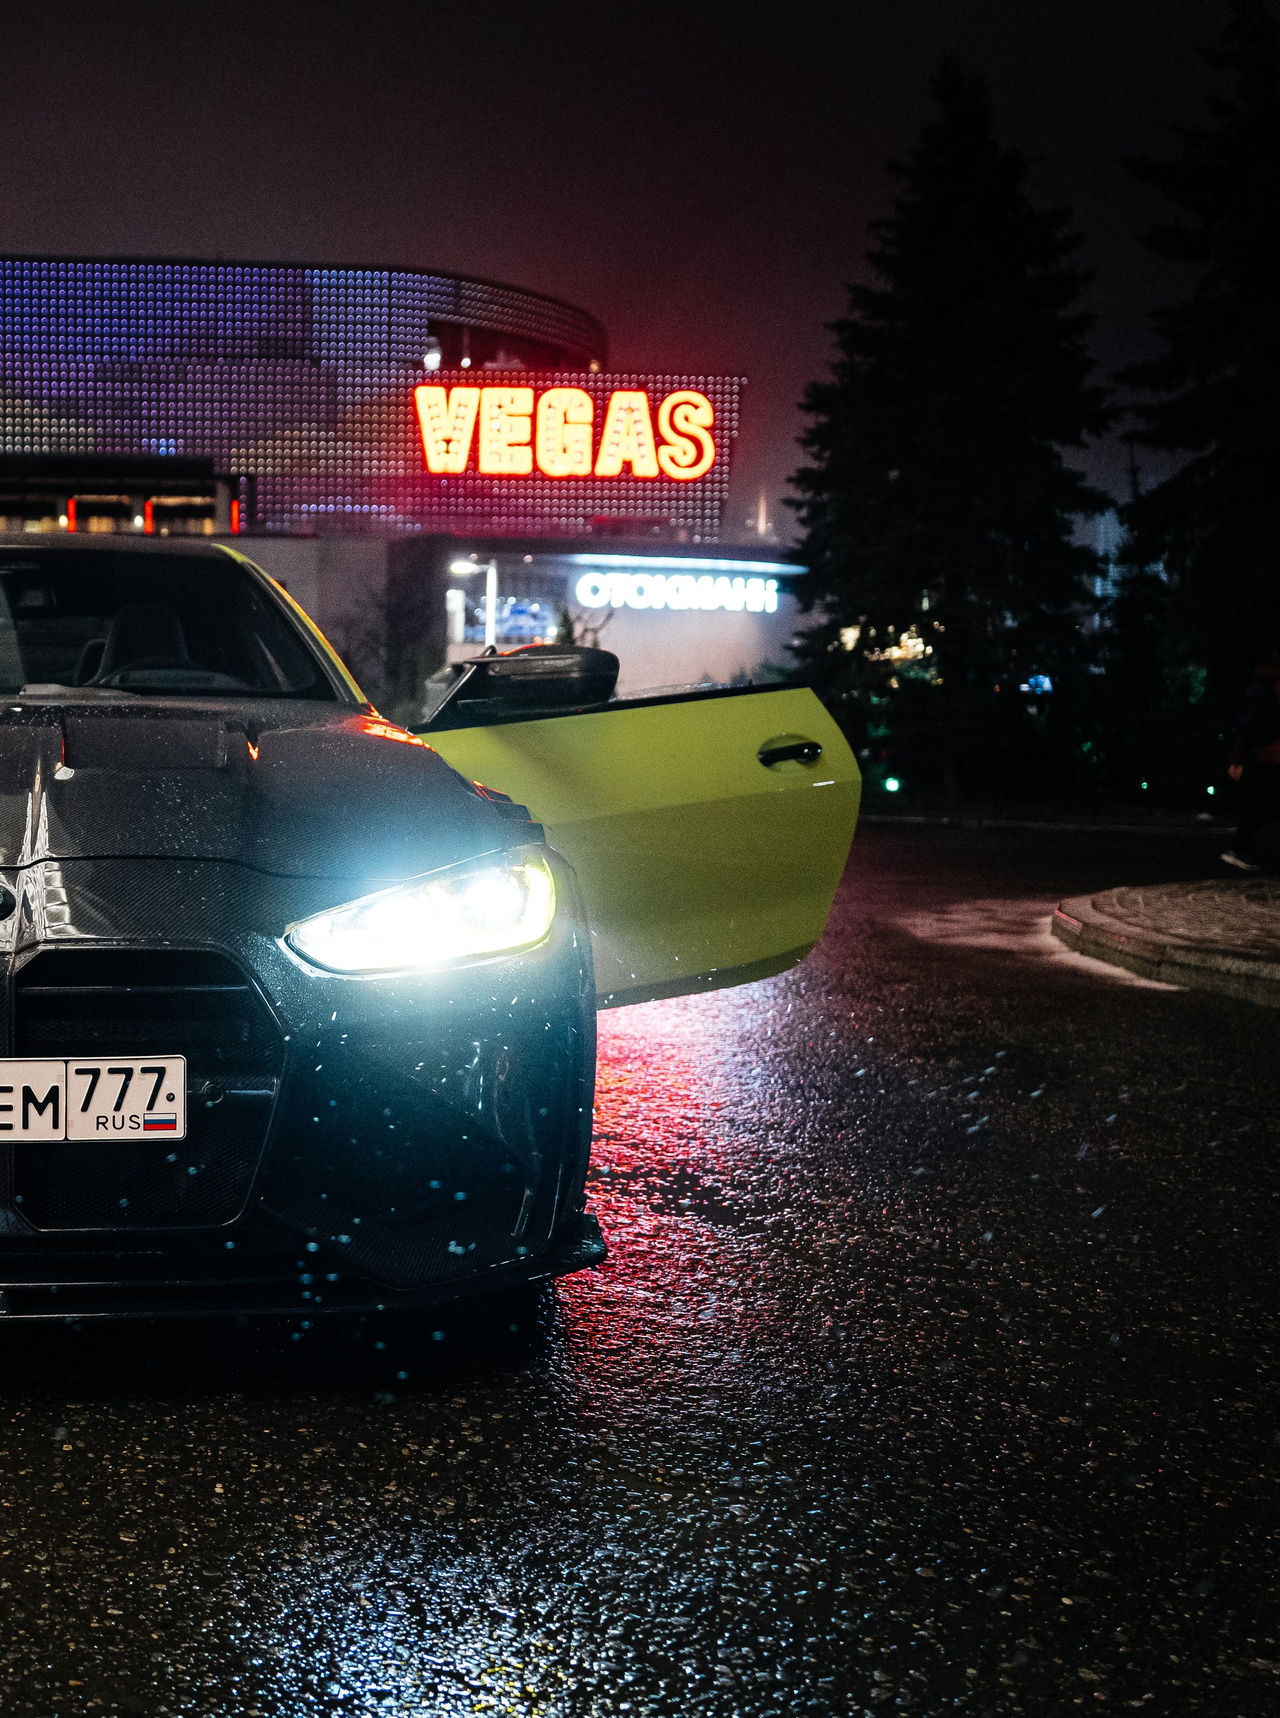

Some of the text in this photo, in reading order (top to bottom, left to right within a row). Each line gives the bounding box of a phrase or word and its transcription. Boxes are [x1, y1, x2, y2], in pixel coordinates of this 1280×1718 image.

[414, 385, 716, 480] VEGAS
[74, 1066, 166, 1112] 777
[95, 1114, 141, 1131] RUS
